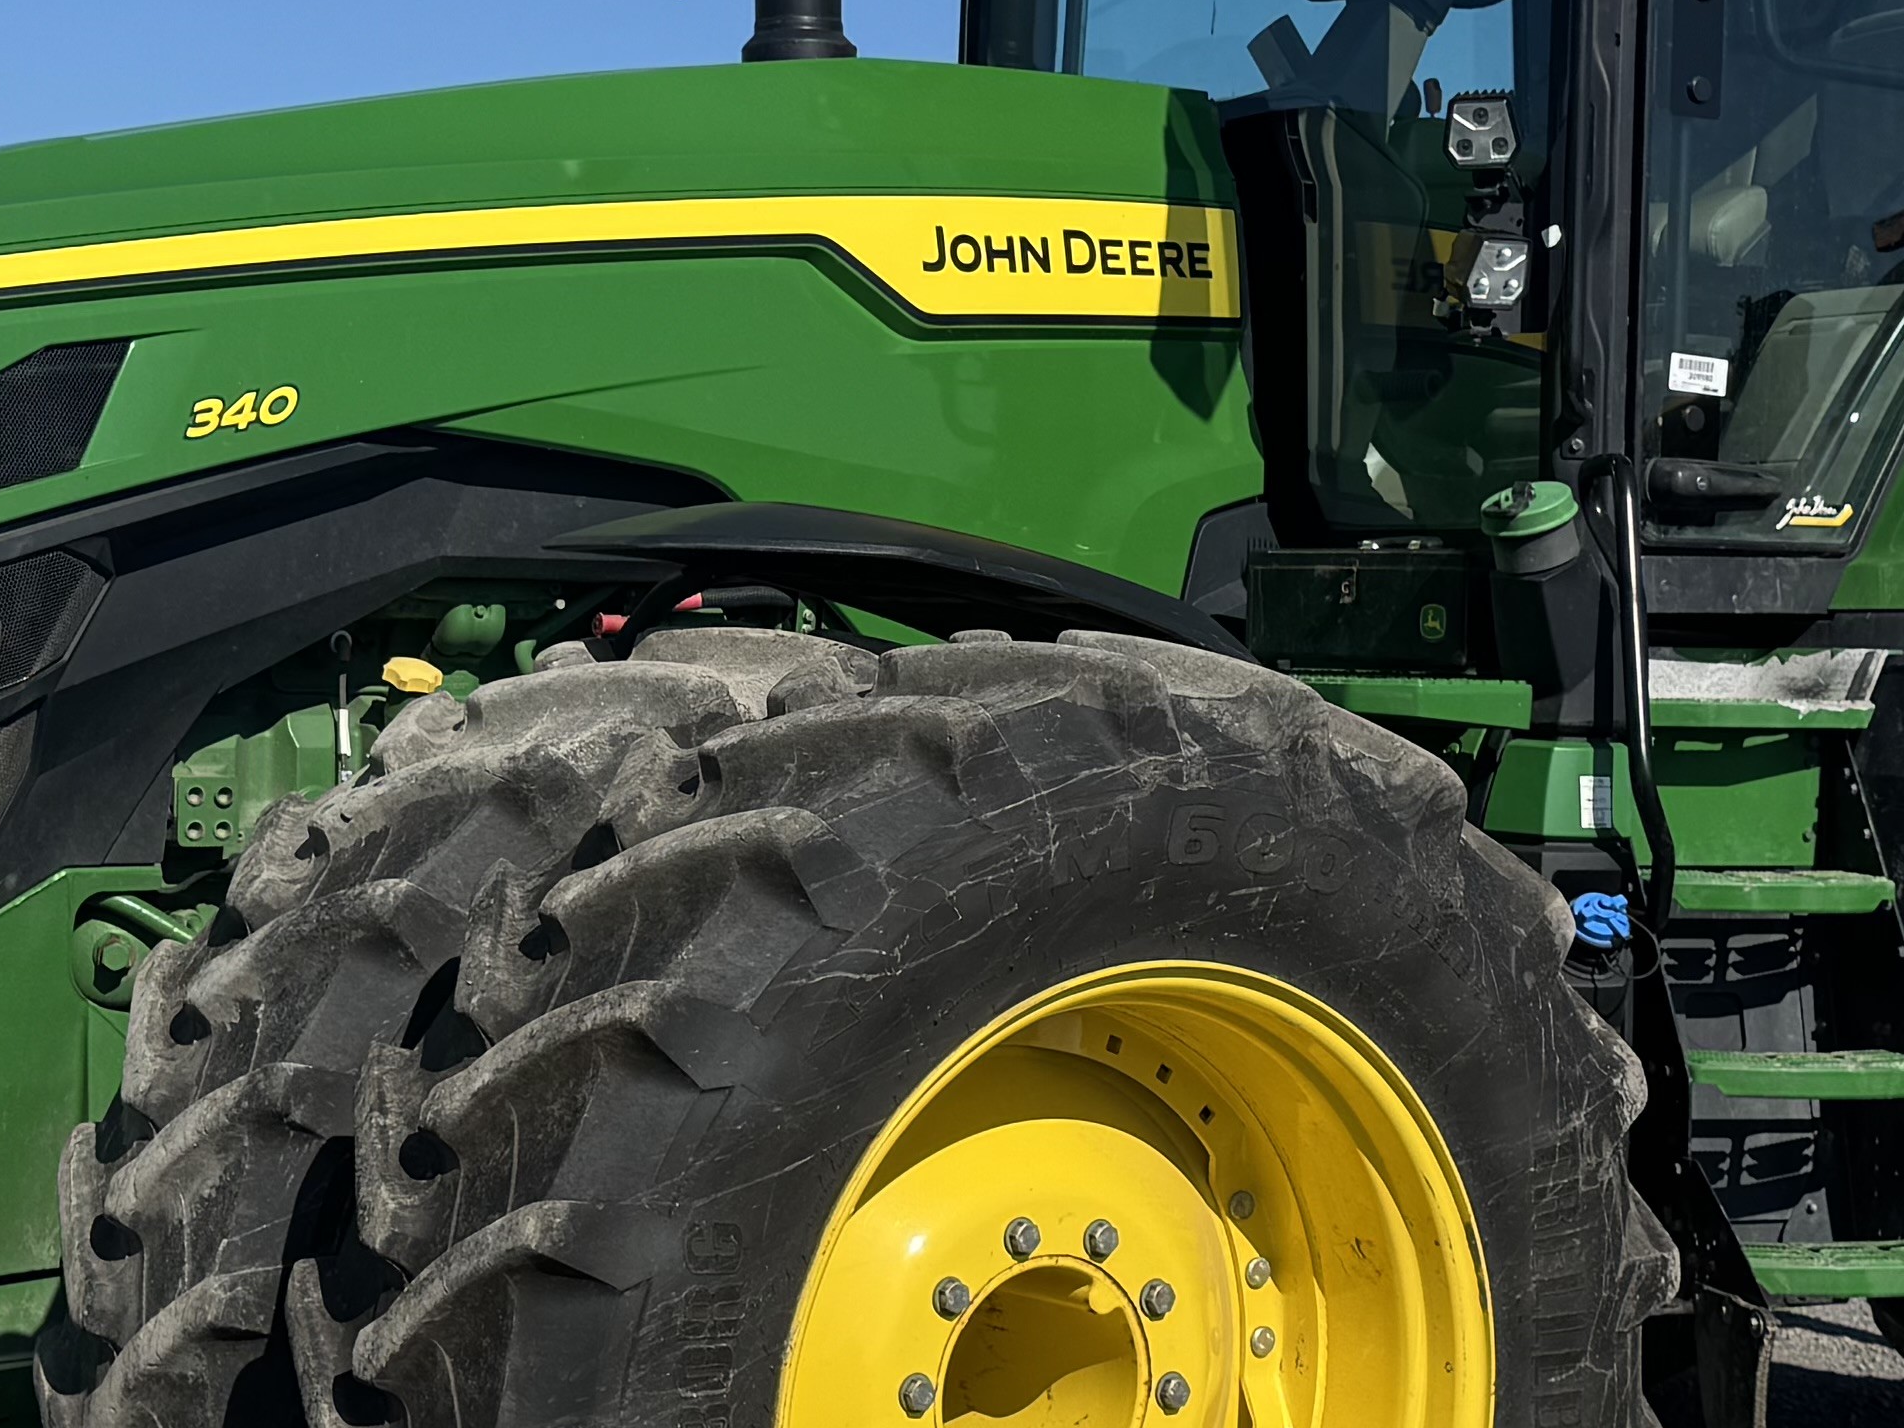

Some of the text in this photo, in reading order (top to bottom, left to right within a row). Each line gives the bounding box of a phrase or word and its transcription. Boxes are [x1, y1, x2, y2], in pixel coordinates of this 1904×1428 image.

[923, 226, 1213, 279] JOHN DEERE
[184, 384, 300, 440] 340
[1165, 802, 1356, 894] 600
